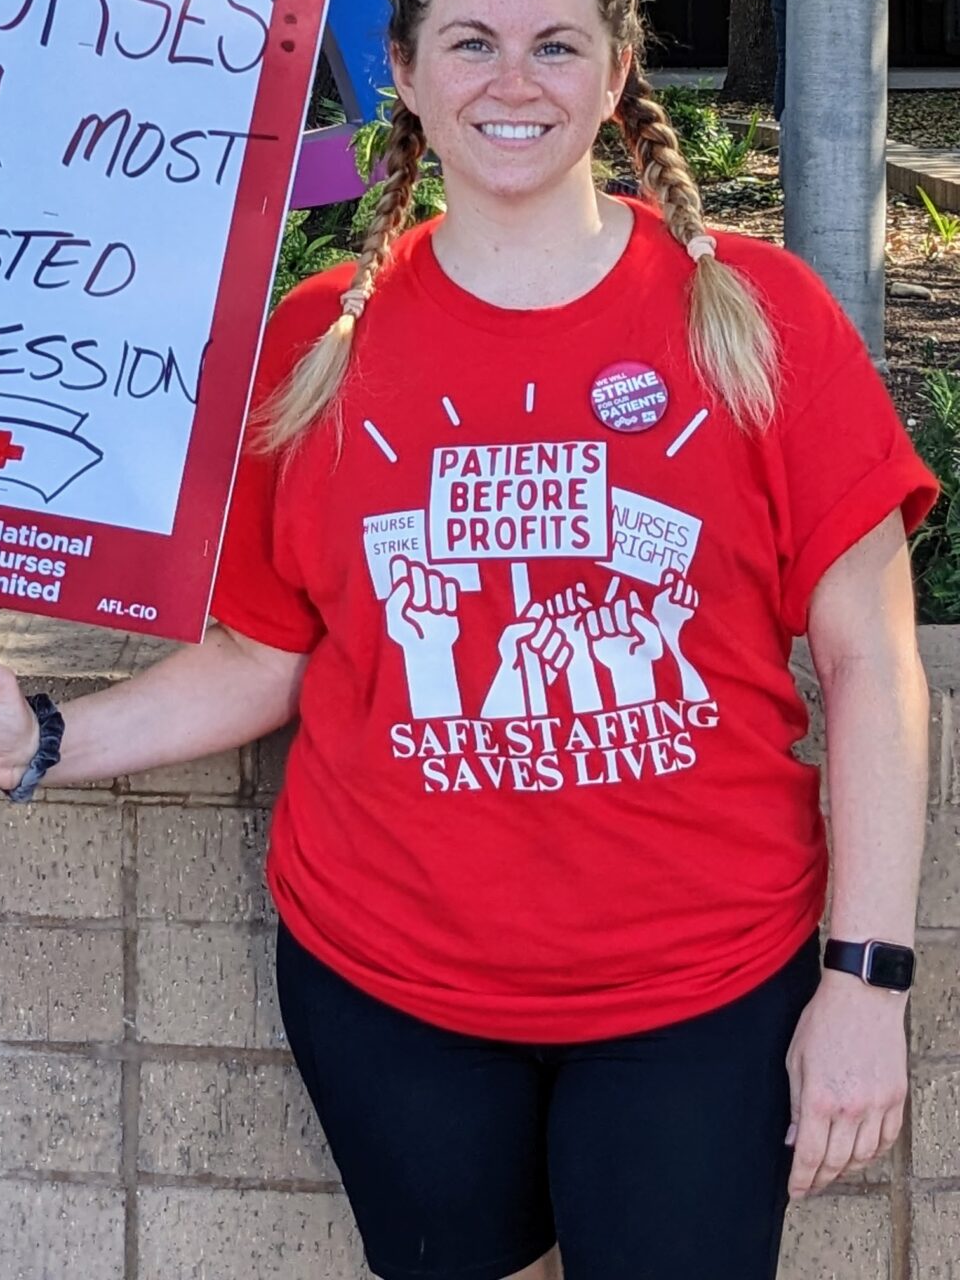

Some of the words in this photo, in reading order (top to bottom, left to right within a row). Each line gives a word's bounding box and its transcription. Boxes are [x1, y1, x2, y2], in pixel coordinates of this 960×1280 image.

[62, 109, 278, 184] MOST
[592, 371, 658, 403] STRIKE
[600, 391, 666, 421] PATIENTS
[439, 444, 601, 478] PATIENTS
[450, 478, 588, 513] BEFORE
[447, 515, 590, 552] PROFITS
[612, 504, 689, 548] NURSES
[373, 537, 420, 556] STRIKE
[613, 532, 689, 574] RIGHTS
[97, 597, 157, 620] AFL-CIO
[390, 719, 499, 758] SAFE
[505, 699, 720, 756] STAFFING
[421, 754, 564, 792] SAVES
[574, 731, 696, 786] LIVES
